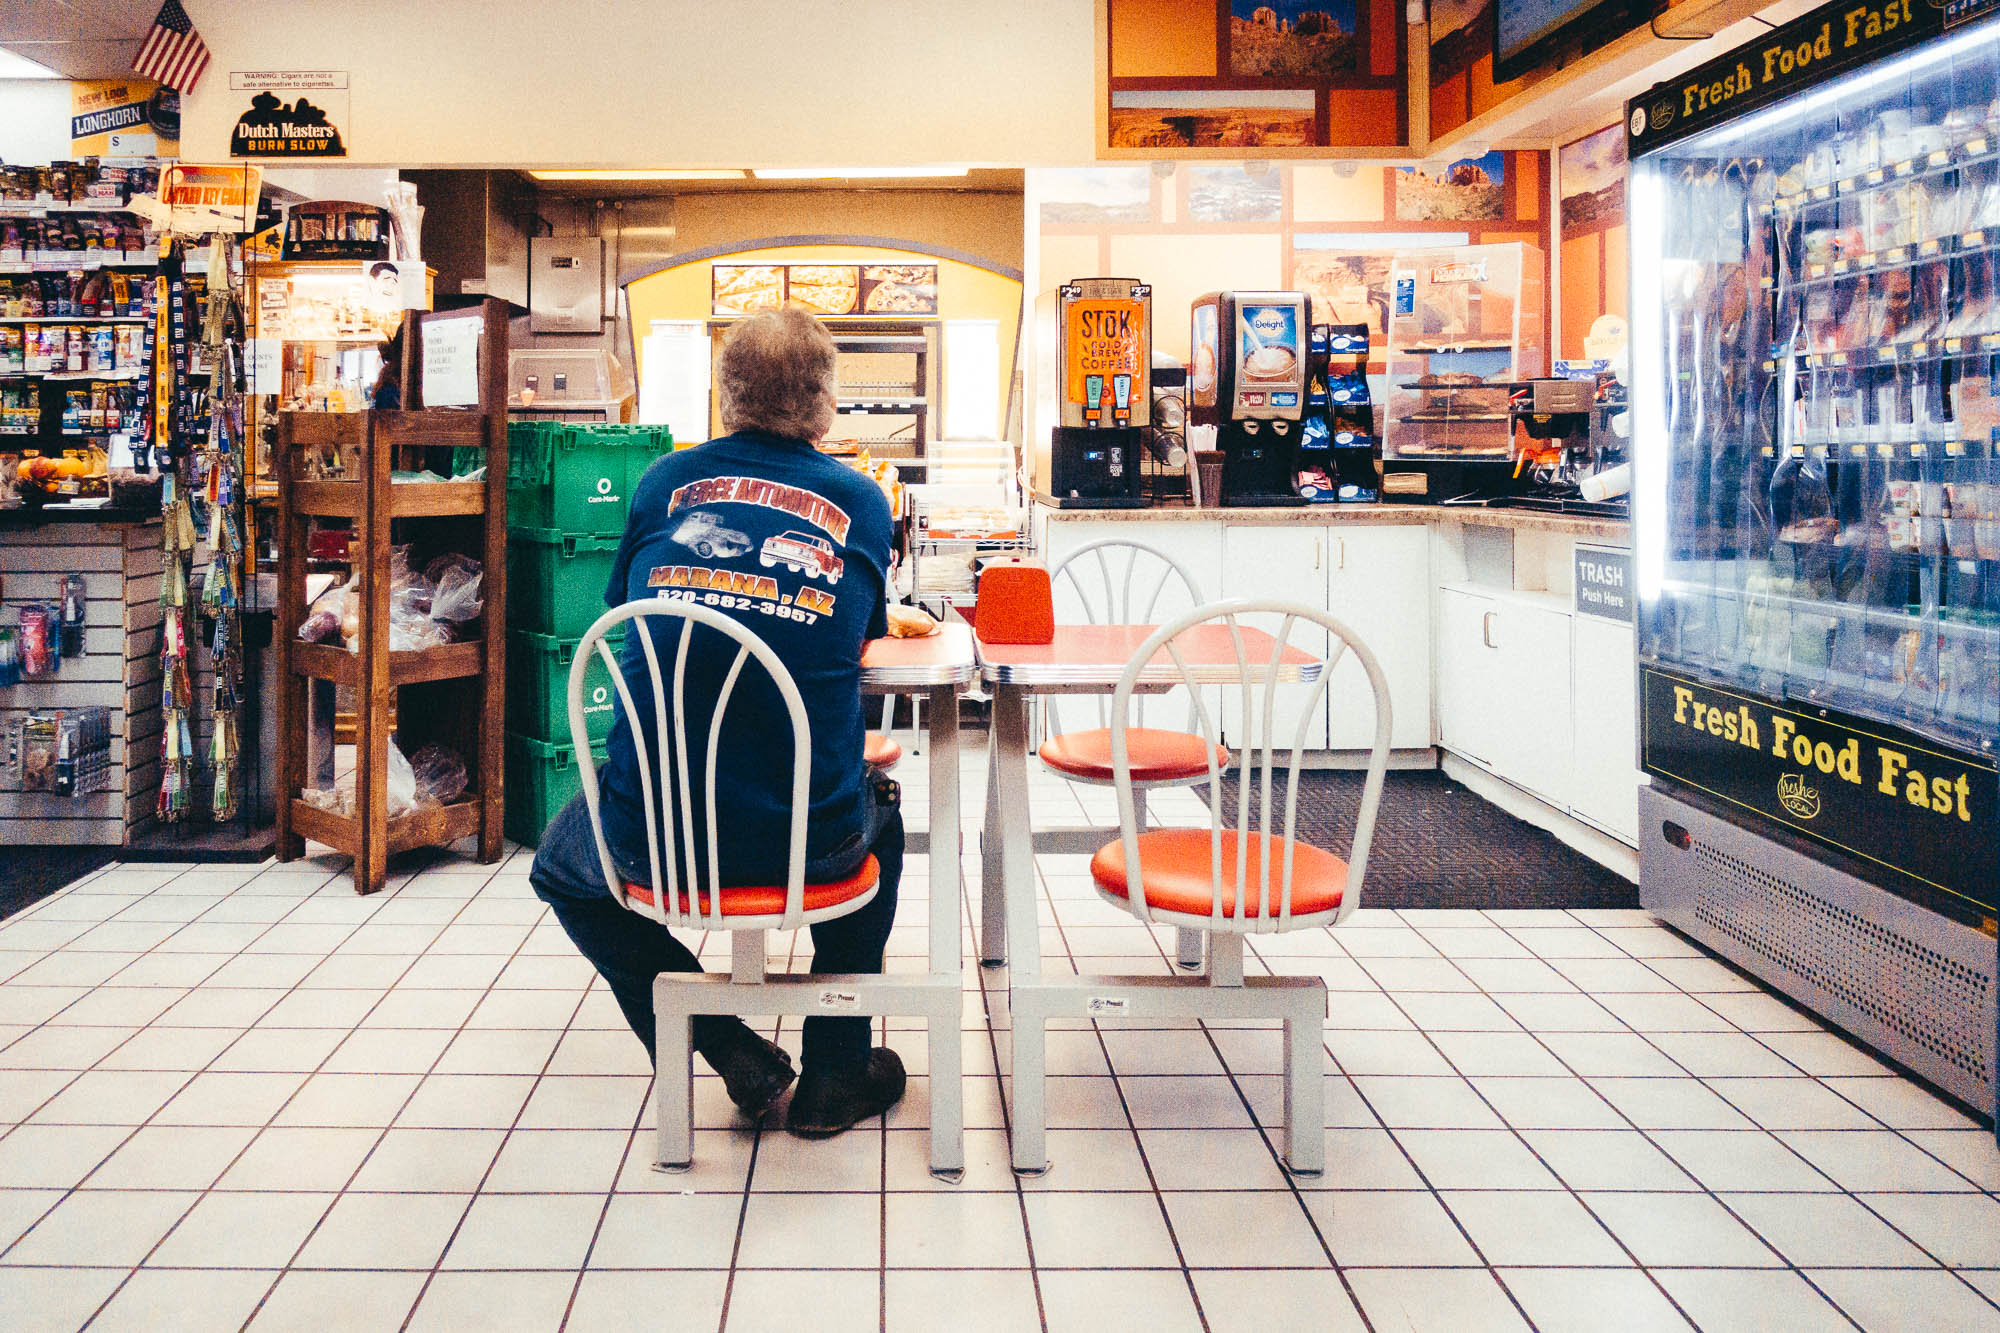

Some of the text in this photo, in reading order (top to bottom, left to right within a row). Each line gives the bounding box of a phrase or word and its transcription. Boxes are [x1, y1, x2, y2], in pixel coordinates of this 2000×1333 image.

[1682, 62, 1753, 119] Fresh
[1761, 23, 1833, 83] Food
[1843, 0, 1913, 47] Fast
[76, 106, 141, 135] LONGHORN
[239, 122, 335, 139] Dutch Masters
[248, 140, 329, 151] BURN SLOW
[1255, 320, 1285, 330] Delight
[1091, 341, 1121, 349] COLD
[1091, 350, 1121, 358] BREW
[1081, 358, 1131, 369] COFFEE
[732, 476, 851, 547] AUTOMOTIVE
[1579, 561, 1623, 588] TRASH
[657, 590, 818, 625] 520-682-3957
[794, 585, 836, 617] AZ
[1582, 587, 1624, 608] Push Here
[1673, 686, 1971, 822] Fresh Food Fast
